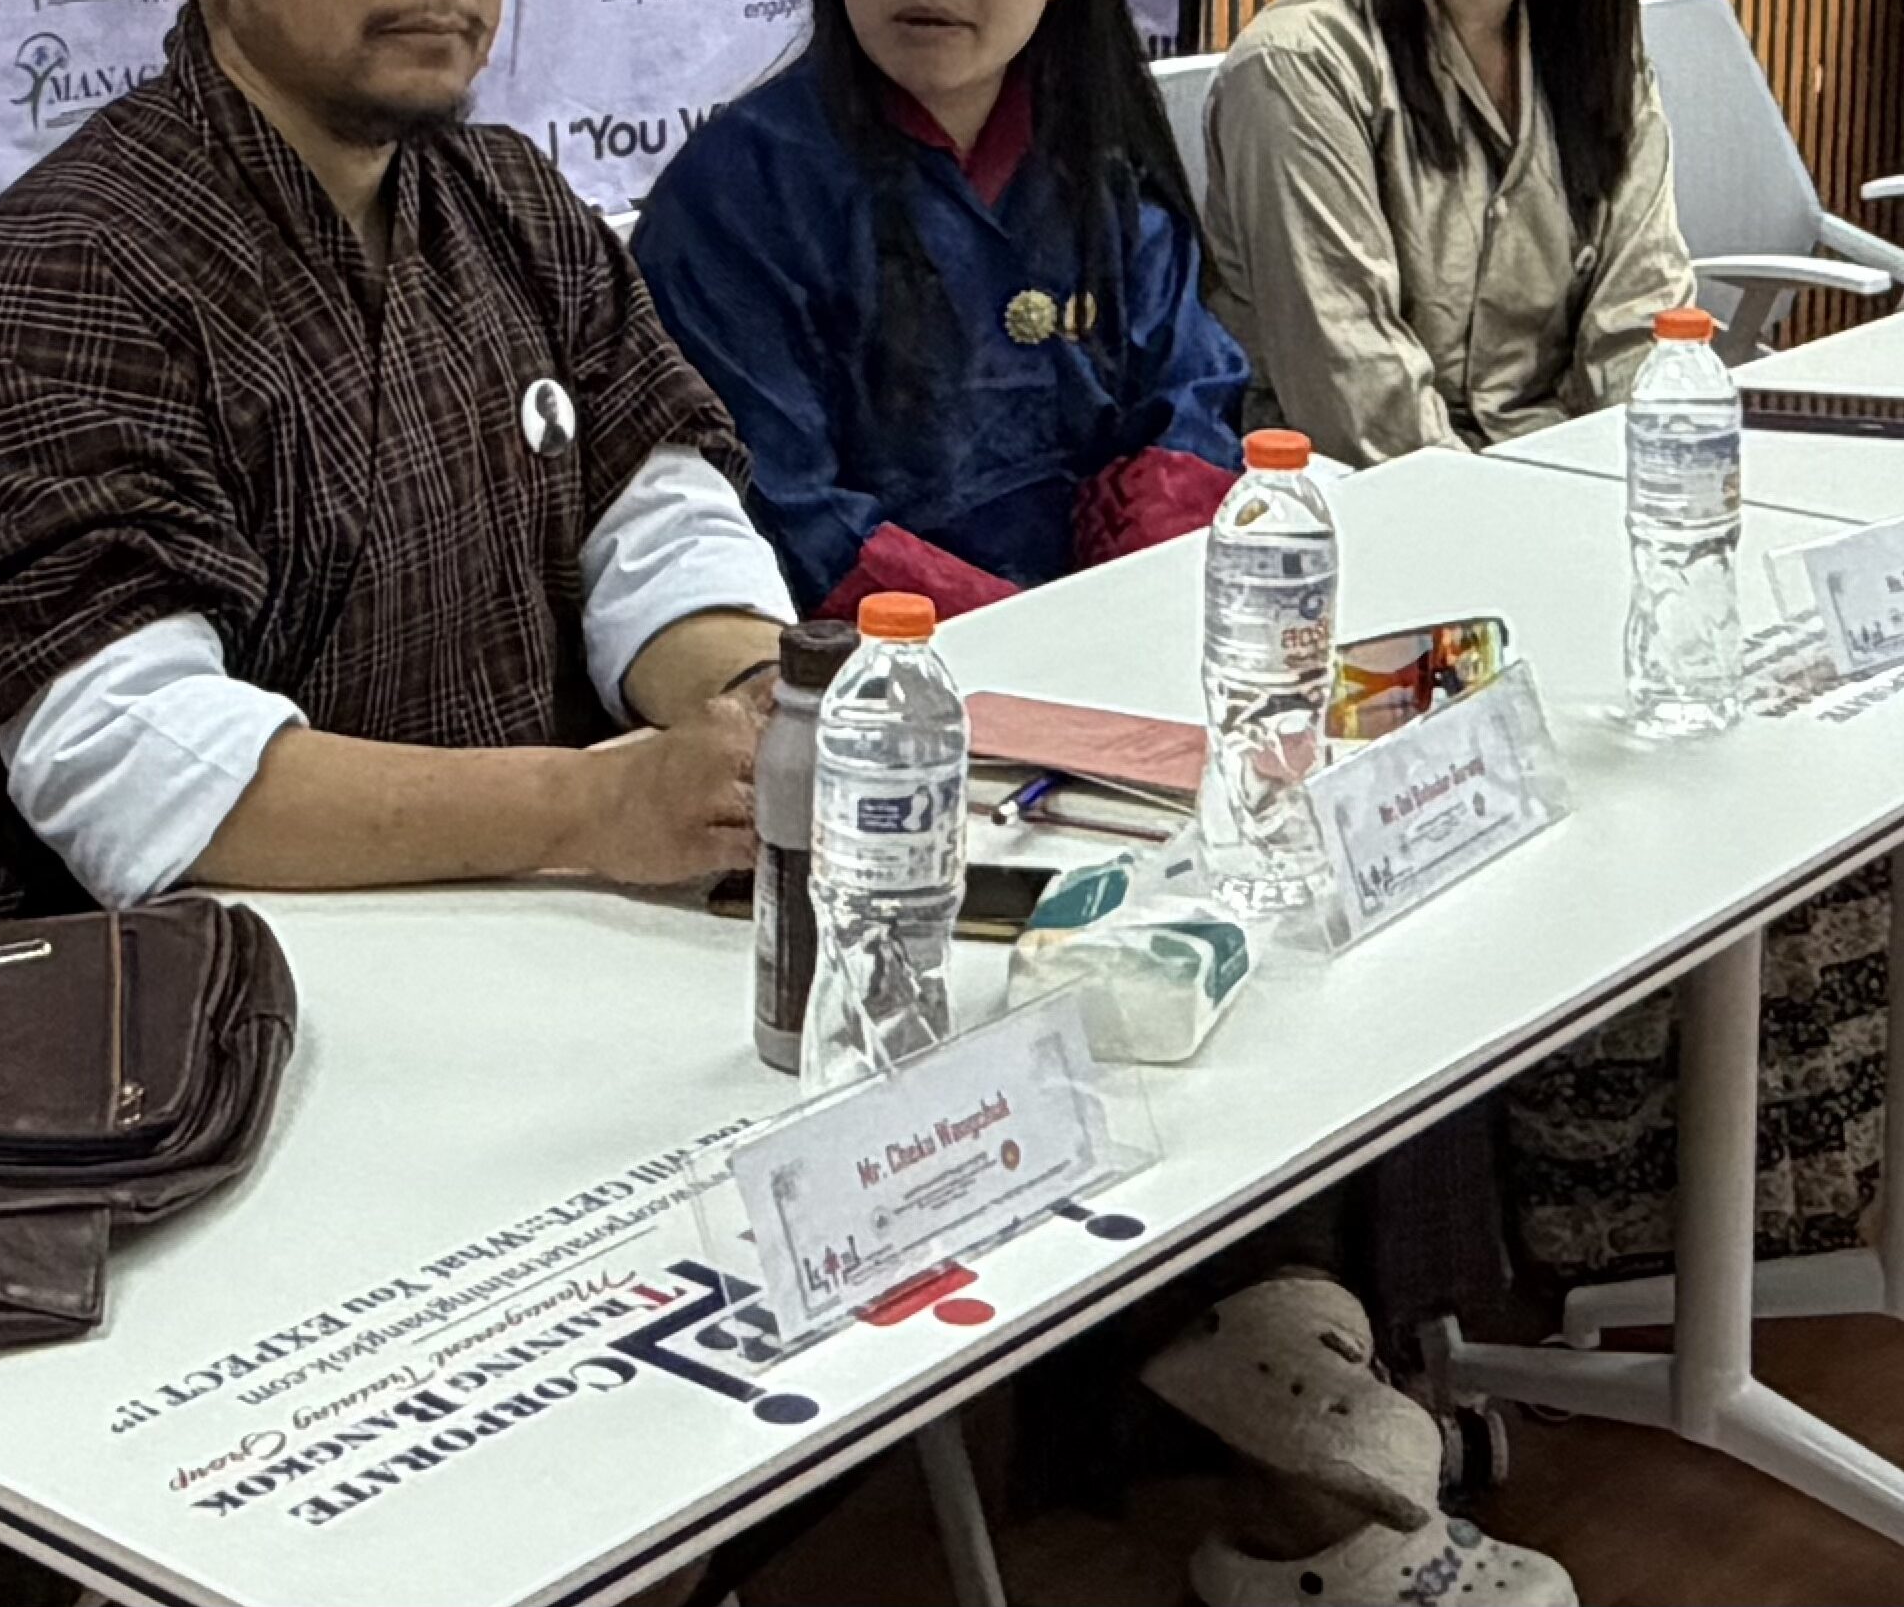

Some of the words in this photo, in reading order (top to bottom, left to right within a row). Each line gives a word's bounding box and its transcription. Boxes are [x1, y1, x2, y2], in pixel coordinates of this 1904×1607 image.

[342, 1277, 433, 1315] You
[445, 1281, 688, 1394] TRAINING
[156, 1311, 352, 1408] EXPECT
[169, 1429, 287, 1492] Group
[190, 1388, 469, 1518] BANGKOK
[287, 1354, 640, 1526] CORPORATE
